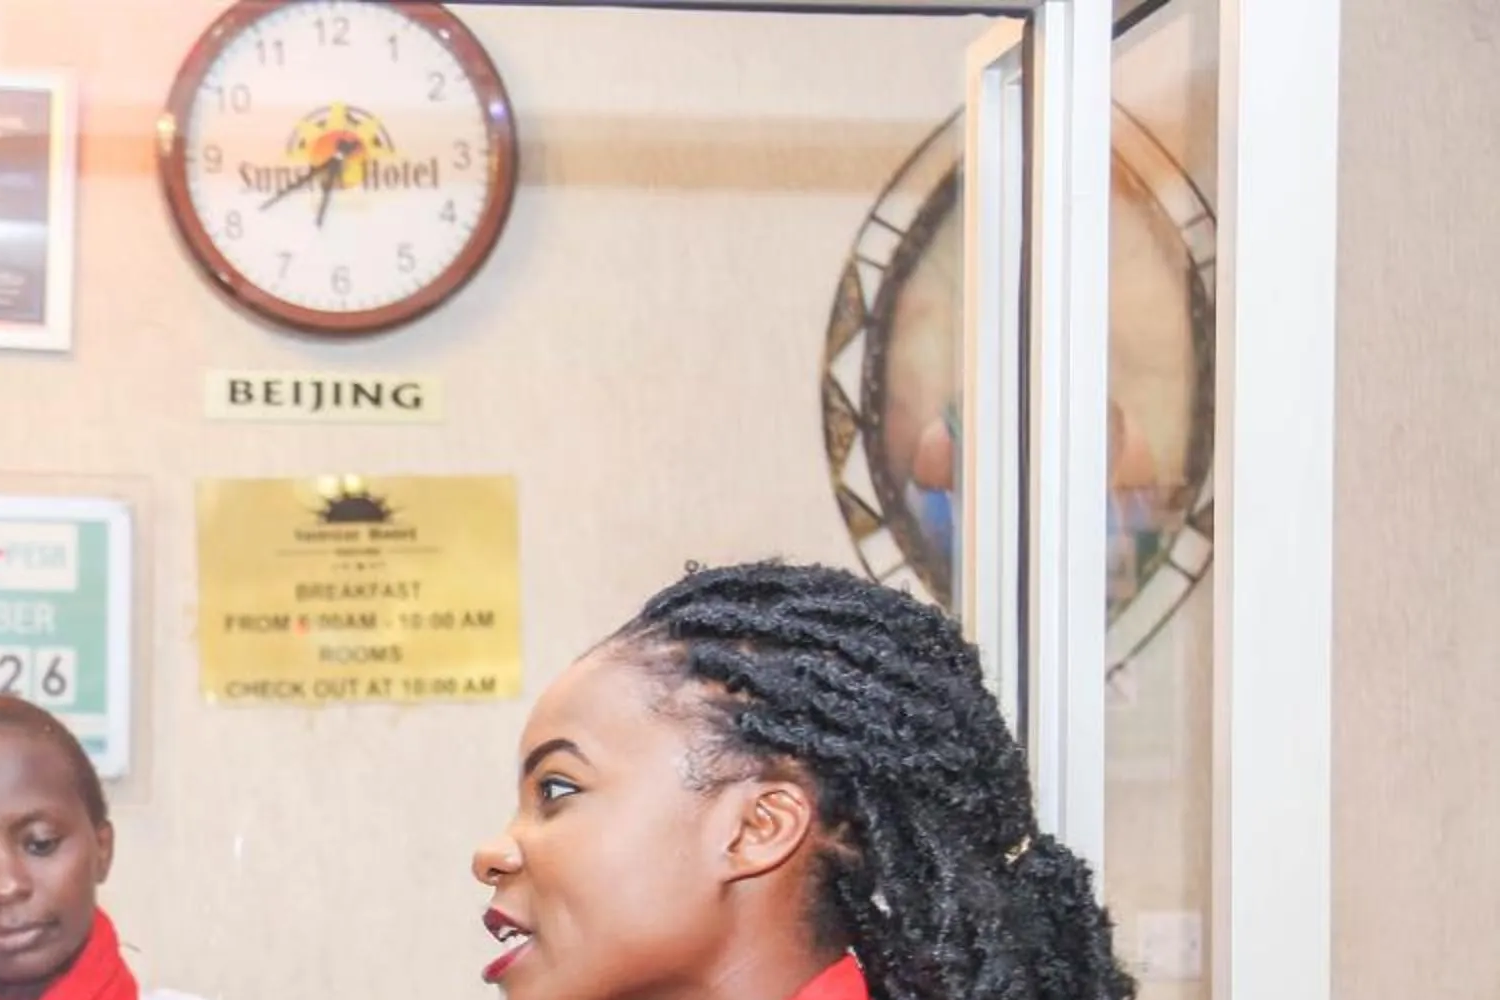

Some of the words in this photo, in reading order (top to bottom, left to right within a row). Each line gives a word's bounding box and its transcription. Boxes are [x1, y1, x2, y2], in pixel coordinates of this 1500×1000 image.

[314, 18, 350, 46] 12
[256, 40, 285, 66] 11
[387, 35, 400, 62] 1
[216, 84, 250, 113] 10
[427, 73, 446, 101] 2
[204, 144, 224, 174] 9
[453, 142, 471, 171] 3
[239, 161, 354, 193] Suns
[362, 156, 439, 190] Hotel
[224, 210, 244, 240] 8
[438, 199, 457, 226] 4
[277, 252, 293, 280] 7
[397, 244, 416, 274] 5
[331, 266, 351, 296] 6
[228, 379, 424, 411] BEIJING
[224, 613, 290, 632] FROM
[461, 610, 495, 629] AM
[319, 646, 404, 663] ROOMS
[224, 681, 306, 699] CHECK
[313, 679, 360, 699] OUT
[366, 677, 393, 697] AT
[463, 676, 497, 694] AM
